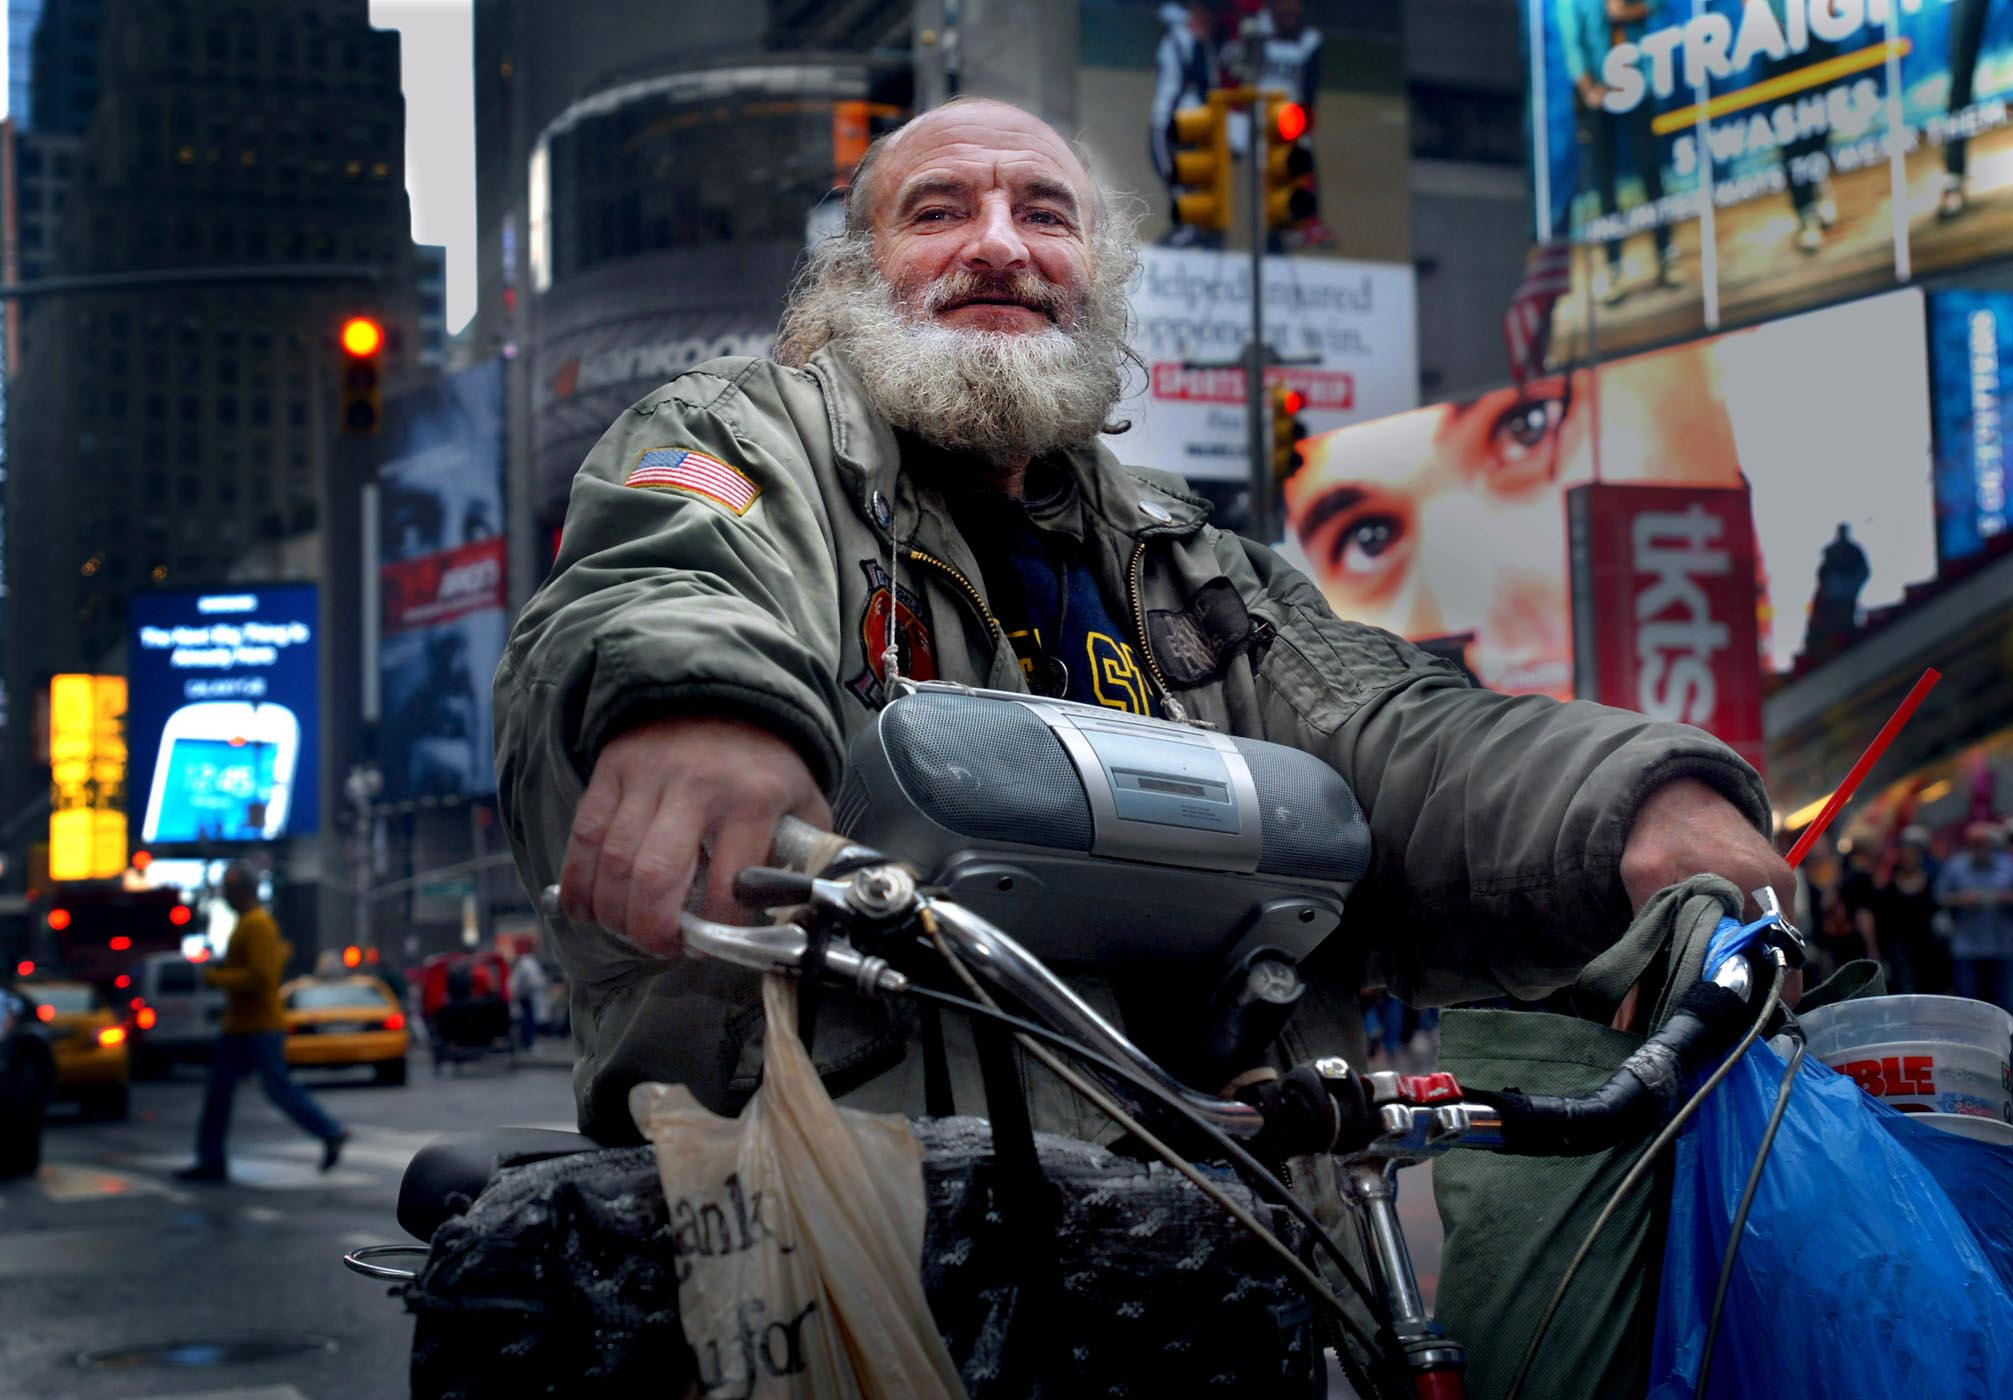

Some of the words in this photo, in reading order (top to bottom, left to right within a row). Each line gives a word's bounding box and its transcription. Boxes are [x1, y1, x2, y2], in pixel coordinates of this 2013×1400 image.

[1258, 276, 1373, 314] njured
[1632, 502, 1731, 723] tkts
[1832, 1056, 1936, 1097] BLE
